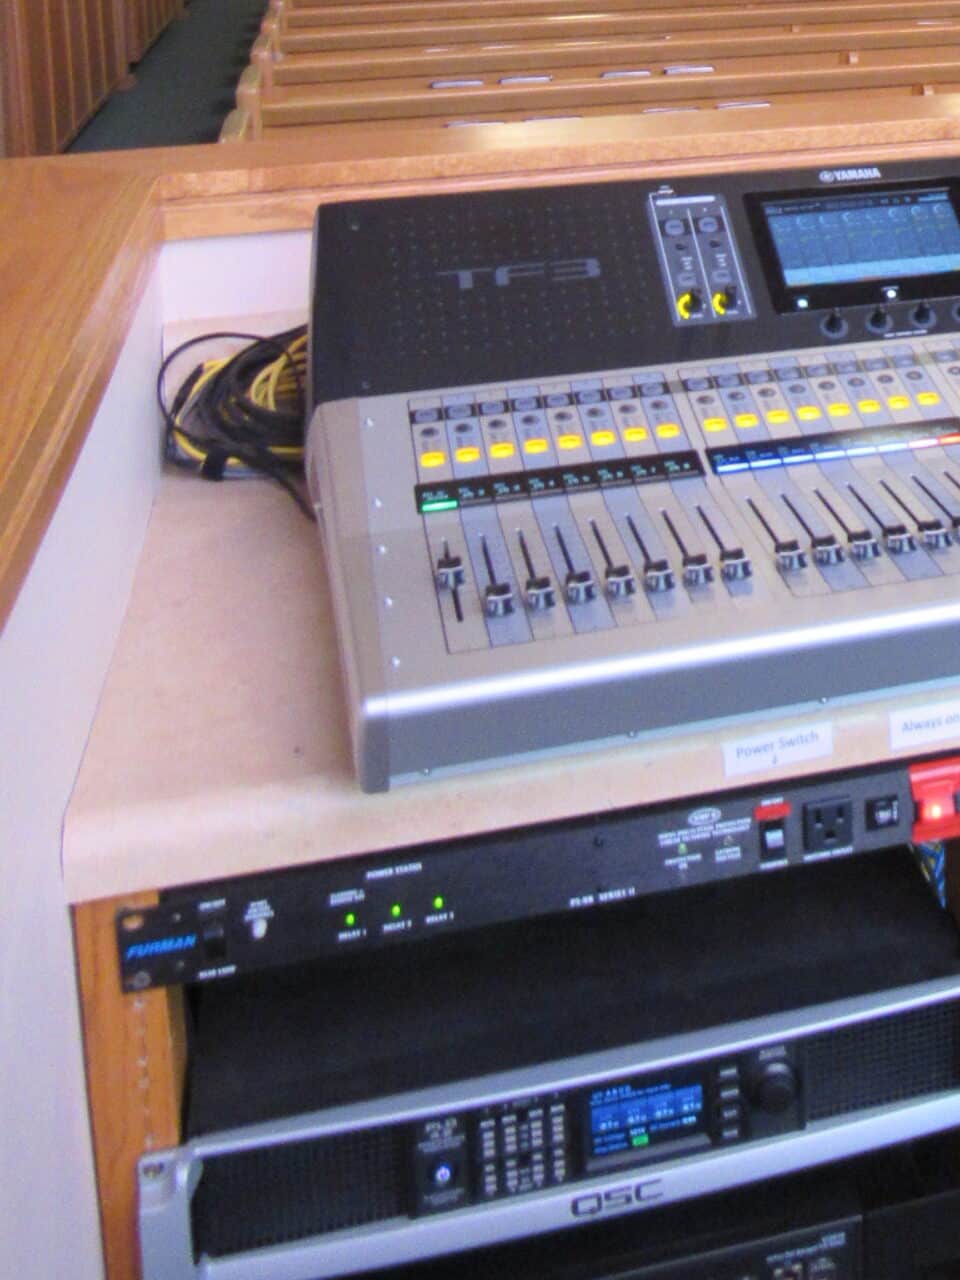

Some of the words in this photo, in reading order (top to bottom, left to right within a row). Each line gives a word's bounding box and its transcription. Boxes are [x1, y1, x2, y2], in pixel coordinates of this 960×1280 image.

[835, 166, 881, 181] YAMAHA
[901, 715, 942, 733] Always
[945, 714, 960, 726] on
[736, 742, 775, 760] Power
[778, 729, 819, 752] Switch
[125, 933, 199, 961] FURMAN
[571, 1178, 664, 1218] QSC
